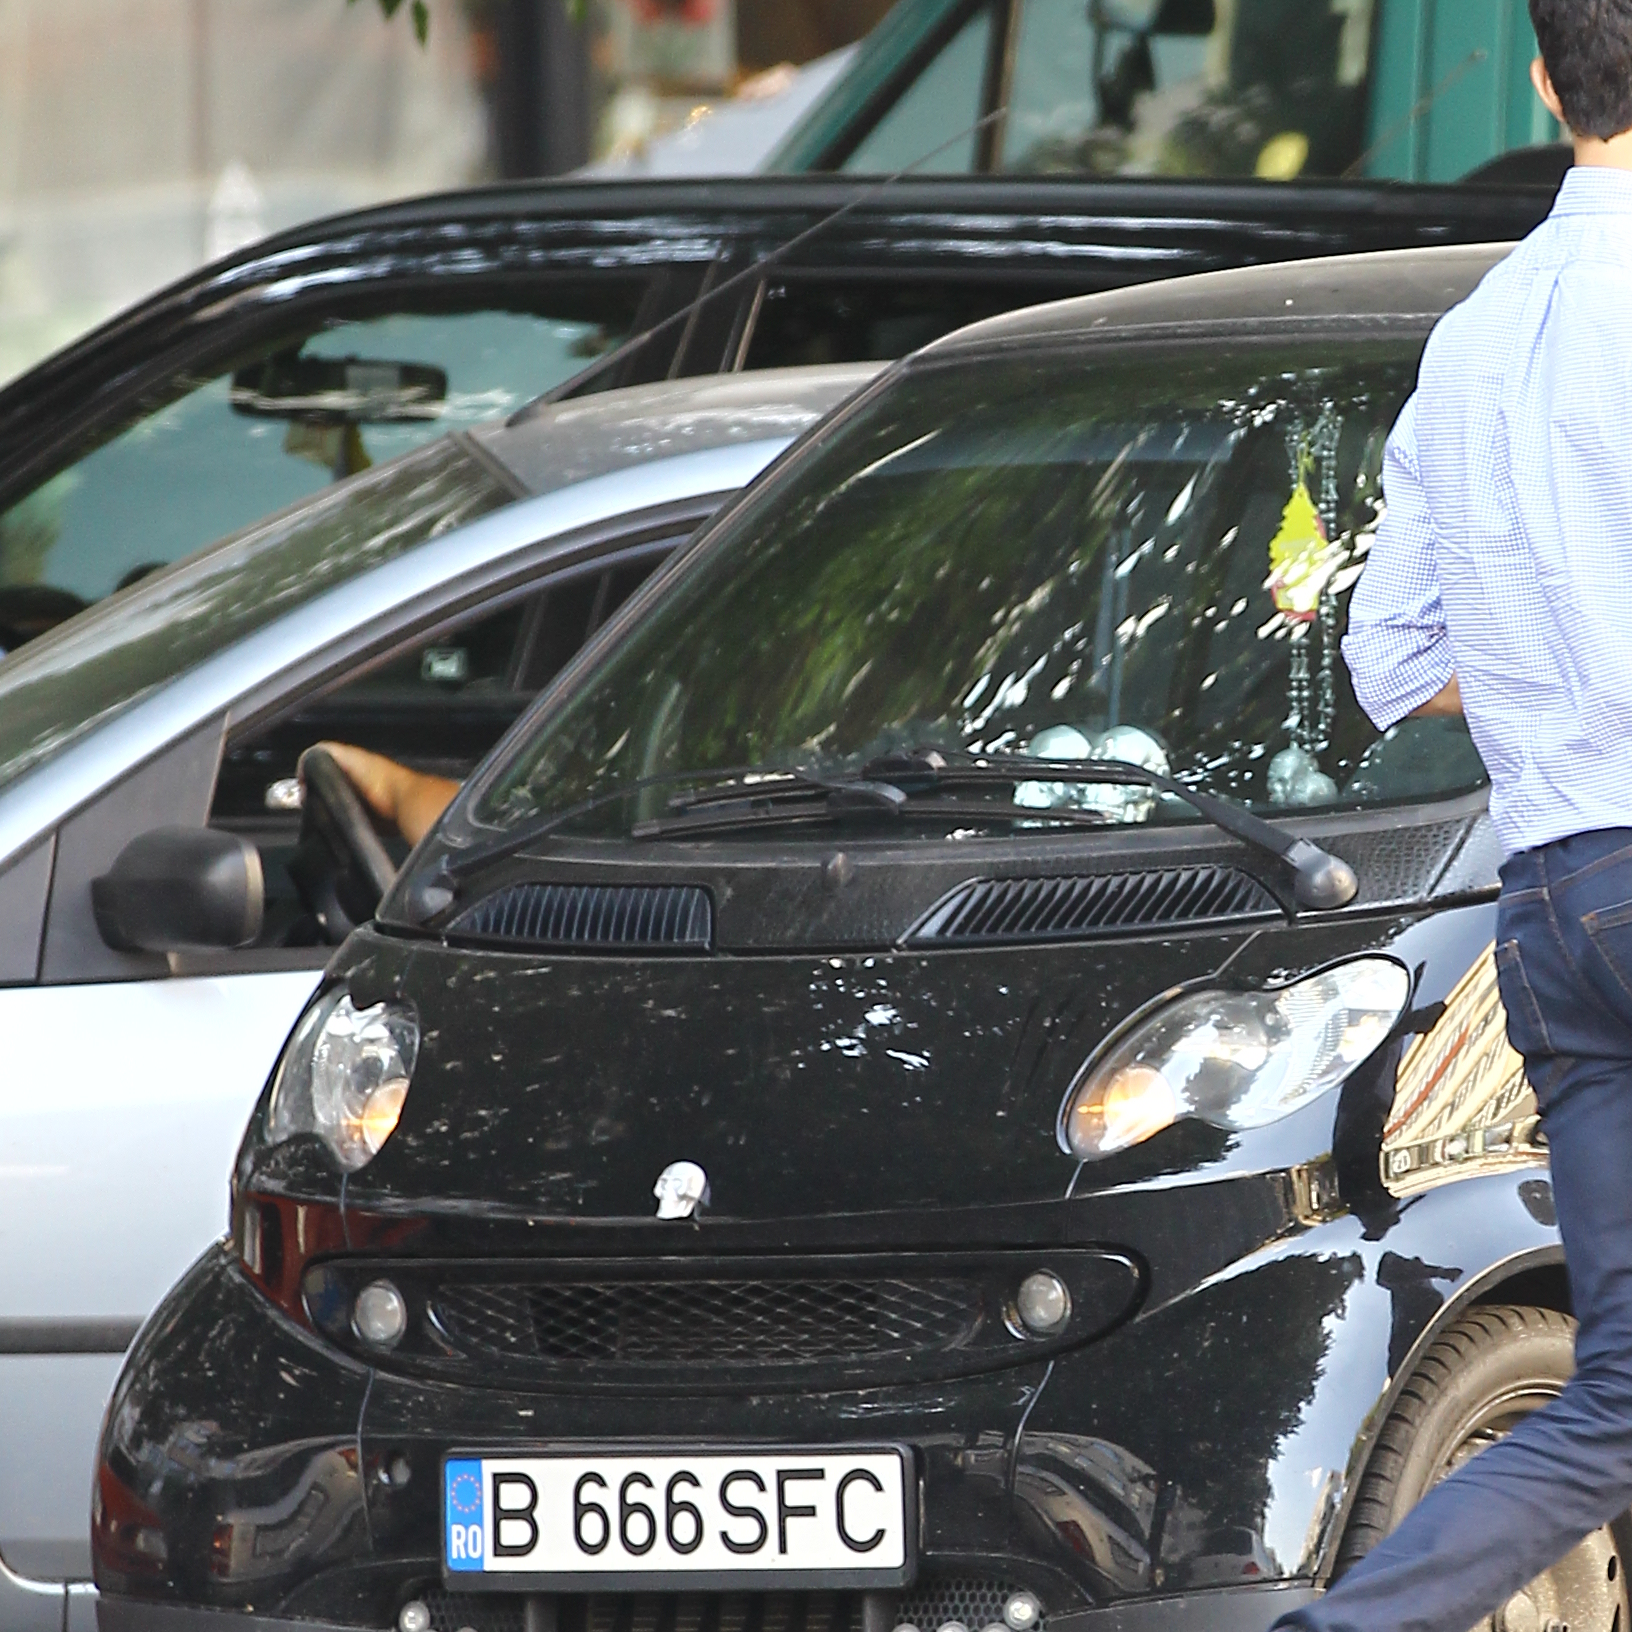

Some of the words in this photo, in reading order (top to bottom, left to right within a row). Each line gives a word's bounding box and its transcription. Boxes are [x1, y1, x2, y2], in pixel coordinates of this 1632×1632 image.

[451, 1523, 482, 1560] RO
[491, 1472, 540, 1558] B
[572, 1468, 887, 1556] 666SFC
